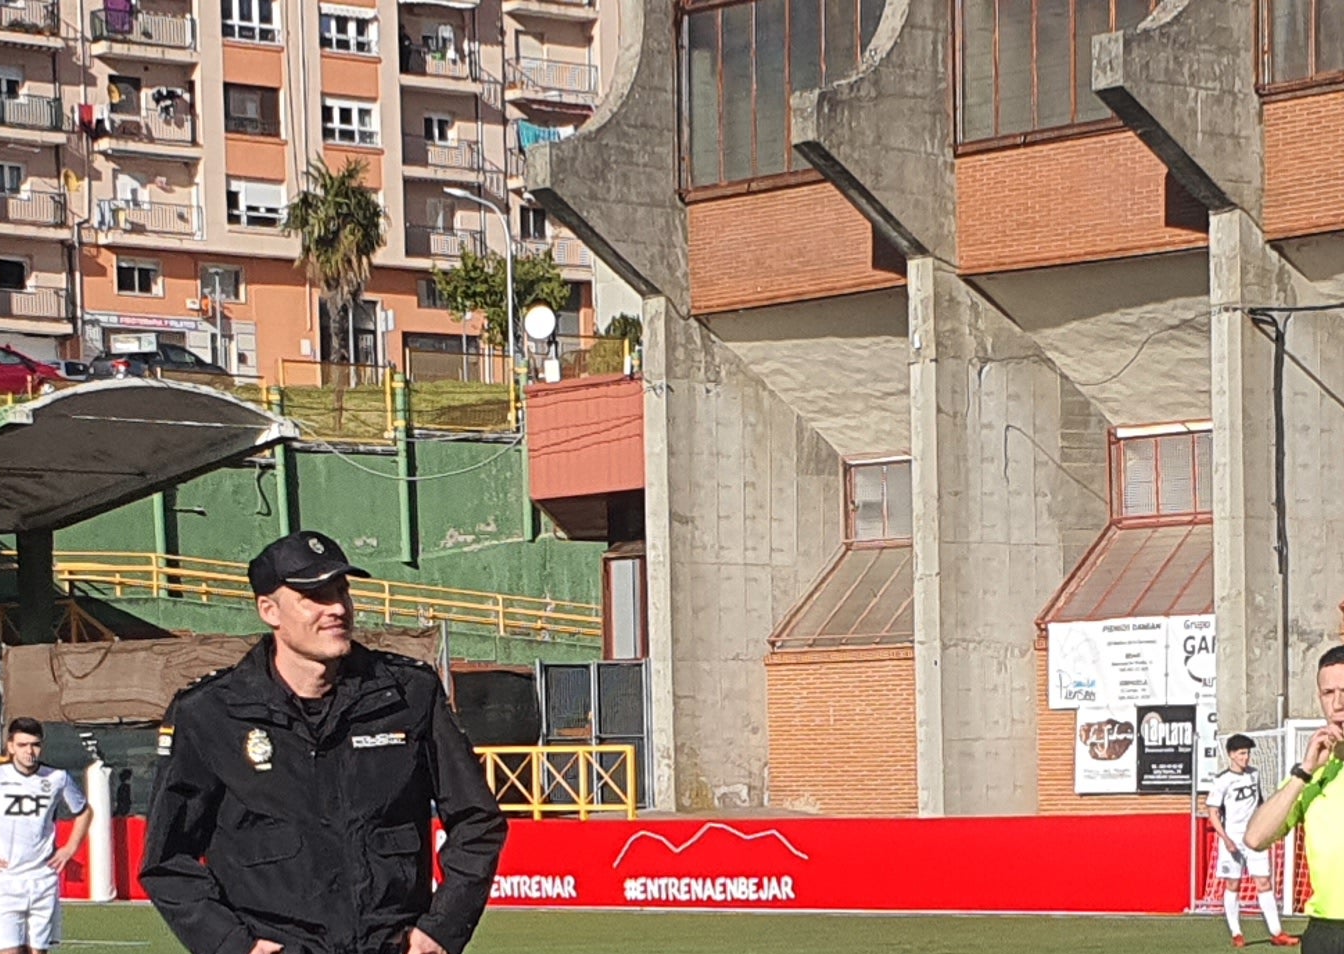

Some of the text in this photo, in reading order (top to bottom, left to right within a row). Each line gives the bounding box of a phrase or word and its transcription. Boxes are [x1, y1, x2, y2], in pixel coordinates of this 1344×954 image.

[1183, 619, 1211, 632] Grupo
[5, 794, 51, 816] ZCF
[490, 874, 577, 899] ENTRENAR
[624, 876, 796, 901] #ENTRENAENBEJAR
